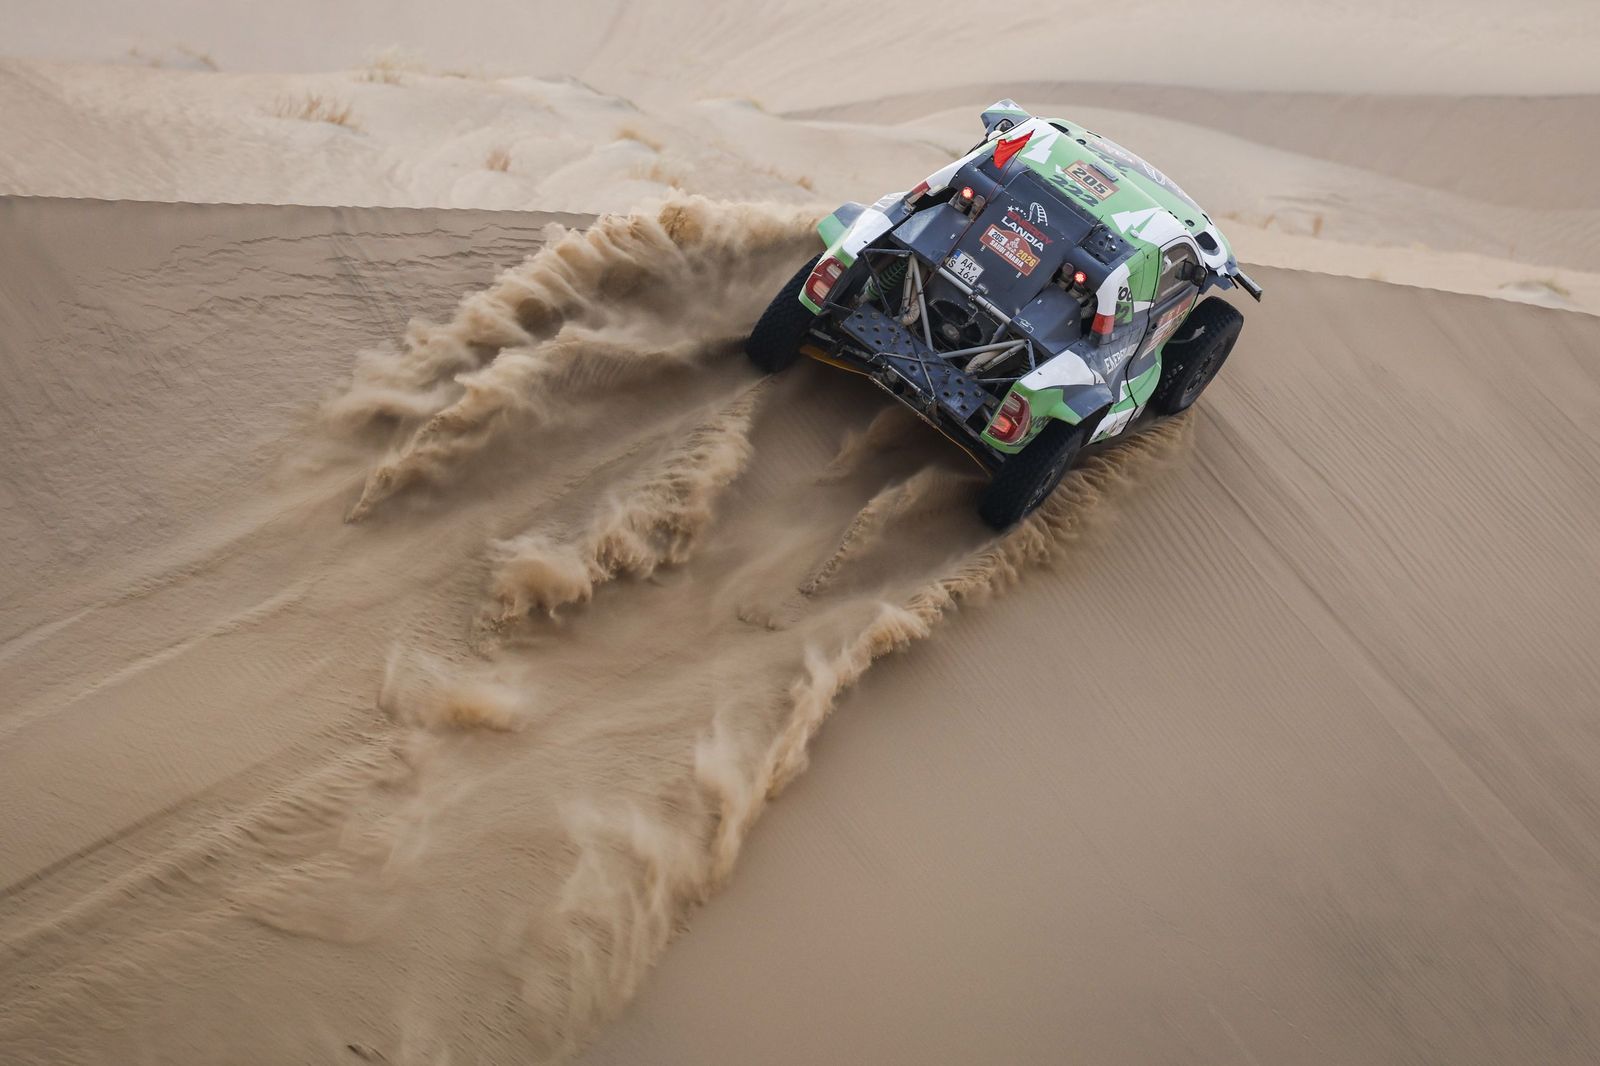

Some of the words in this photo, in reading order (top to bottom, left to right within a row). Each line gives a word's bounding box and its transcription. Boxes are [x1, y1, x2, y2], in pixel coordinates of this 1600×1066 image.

[1048, 174, 1099, 207] 222
[1071, 167, 1109, 195] 205
[1001, 215, 1045, 252] LANDIA
[989, 239, 1007, 256] SAUDI
[1005, 250, 1025, 268] ARABIA
[991, 231, 1004, 243] 205
[1016, 249, 1037, 267] 2026
[957, 268, 978, 283] 164
[960, 258, 974, 271] AA
